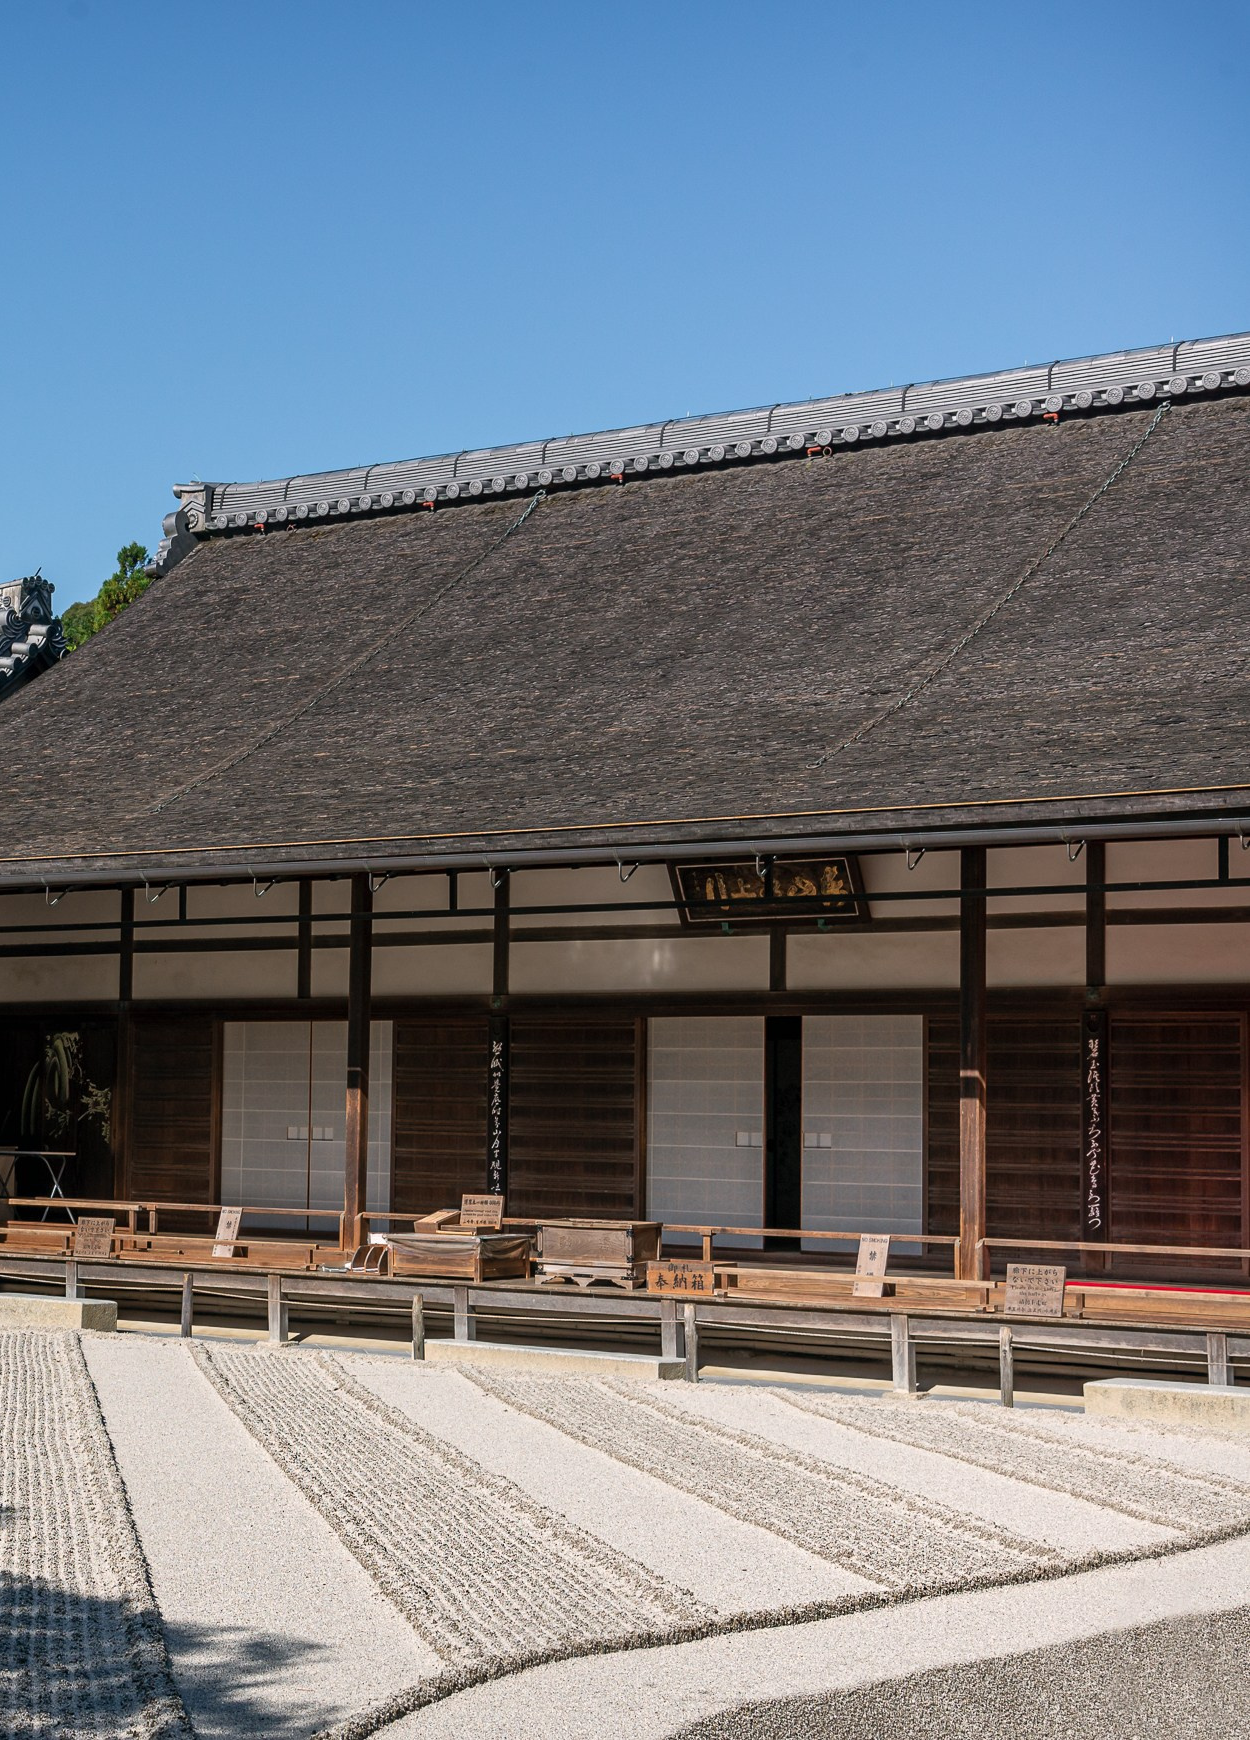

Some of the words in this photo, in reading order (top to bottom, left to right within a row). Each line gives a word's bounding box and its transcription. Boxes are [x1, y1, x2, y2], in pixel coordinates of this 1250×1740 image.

[655, 1272, 704, 1291] 奉納箱
[1012, 1276, 1058, 1285] ないで下さい
